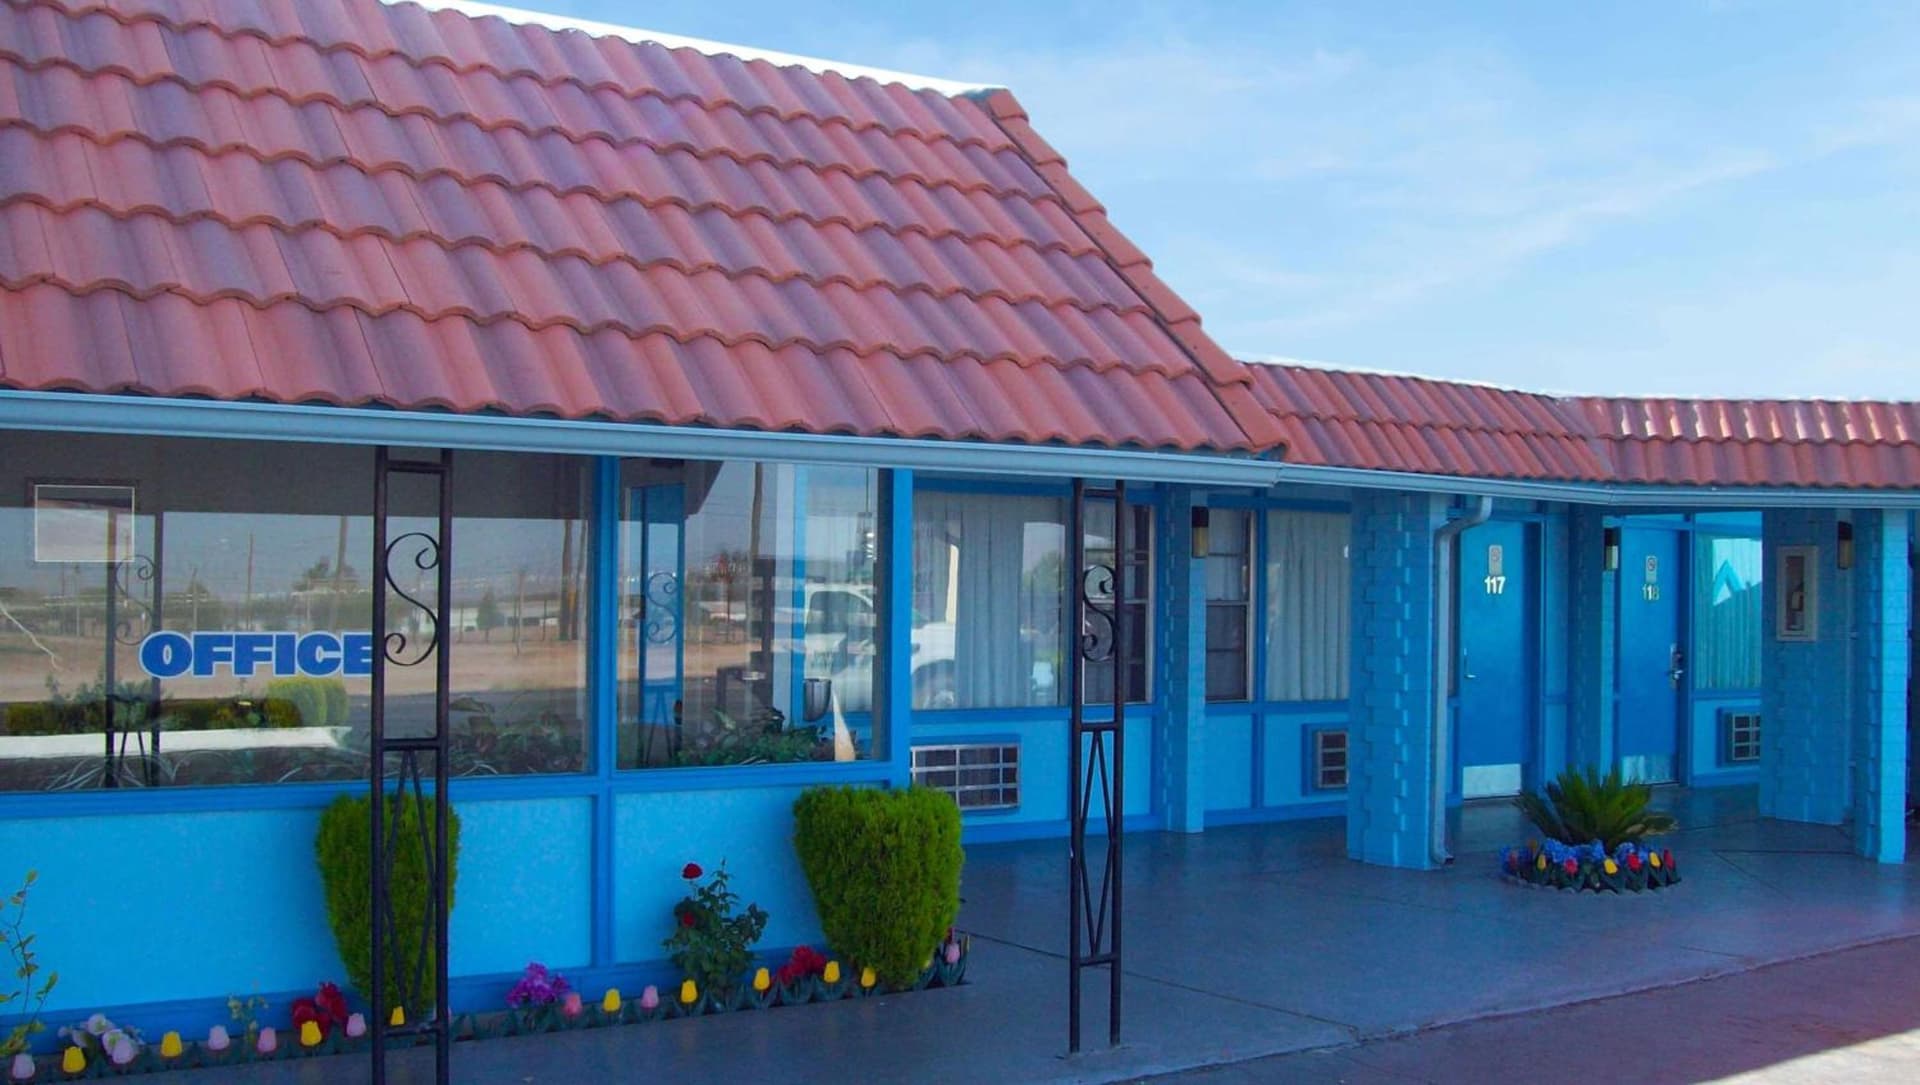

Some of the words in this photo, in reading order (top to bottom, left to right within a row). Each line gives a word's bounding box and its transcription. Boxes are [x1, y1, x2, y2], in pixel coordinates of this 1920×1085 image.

[1484, 576, 1506, 594] 117
[1642, 584, 1660, 600] 118
[140, 631, 372, 679] OFFICE
